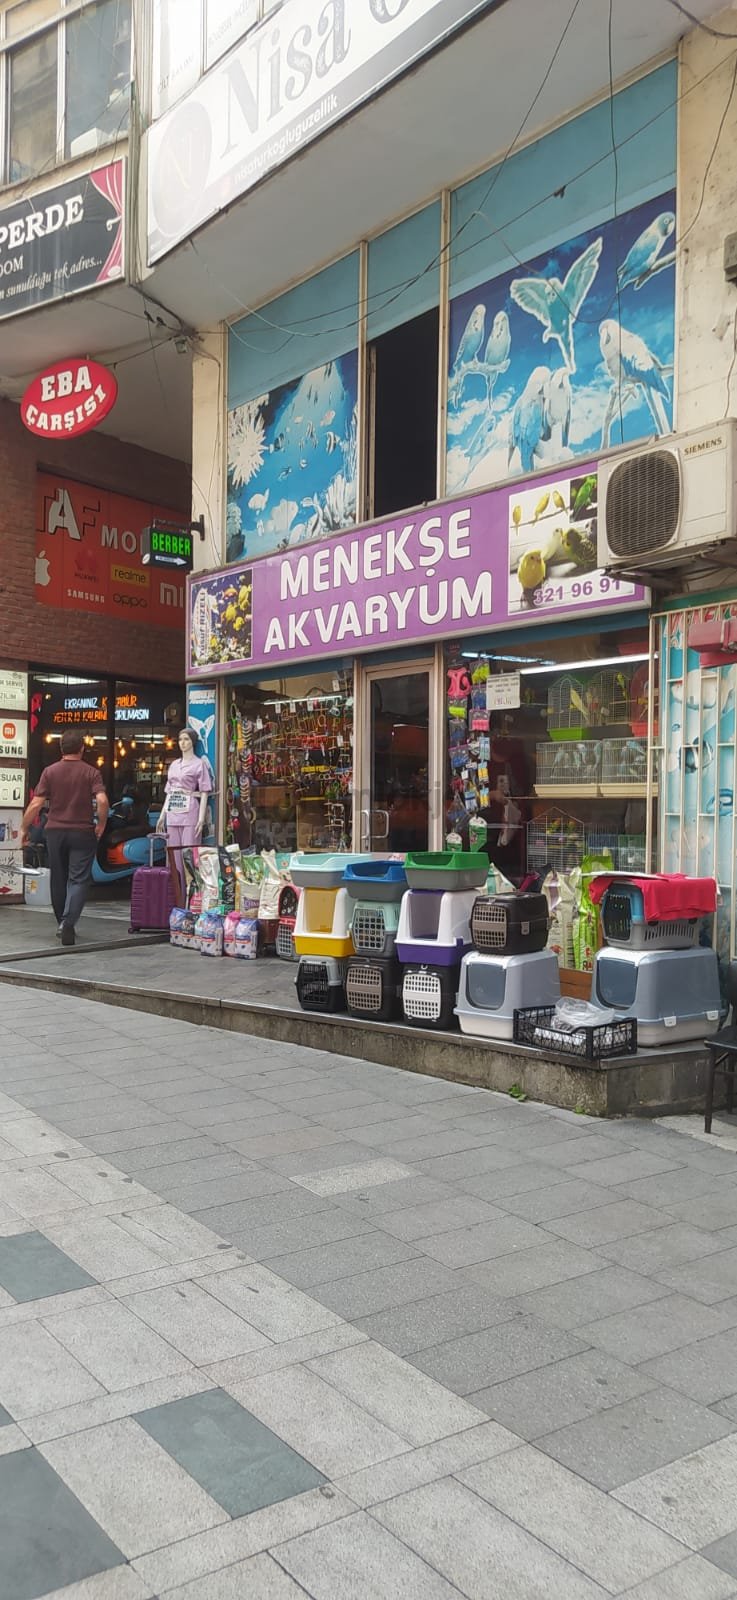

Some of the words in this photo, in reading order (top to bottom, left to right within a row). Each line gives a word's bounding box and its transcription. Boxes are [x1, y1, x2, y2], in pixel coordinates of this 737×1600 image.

[219, 0, 351, 159] Nisa
[53, 260, 71, 279] tek
[40, 365, 92, 403] EBA
[25, 383, 107, 432] ÇARŞISI
[683, 437, 722, 456] SIEMENS
[152, 531, 191, 557] BERBER
[279, 508, 472, 602] MENEKŞE
[114, 568, 146, 584] realme
[66, 588, 105, 603] SAMSUNG
[533, 585, 564, 606] 321
[571, 580, 593, 598] 96
[600, 576, 621, 594] 91
